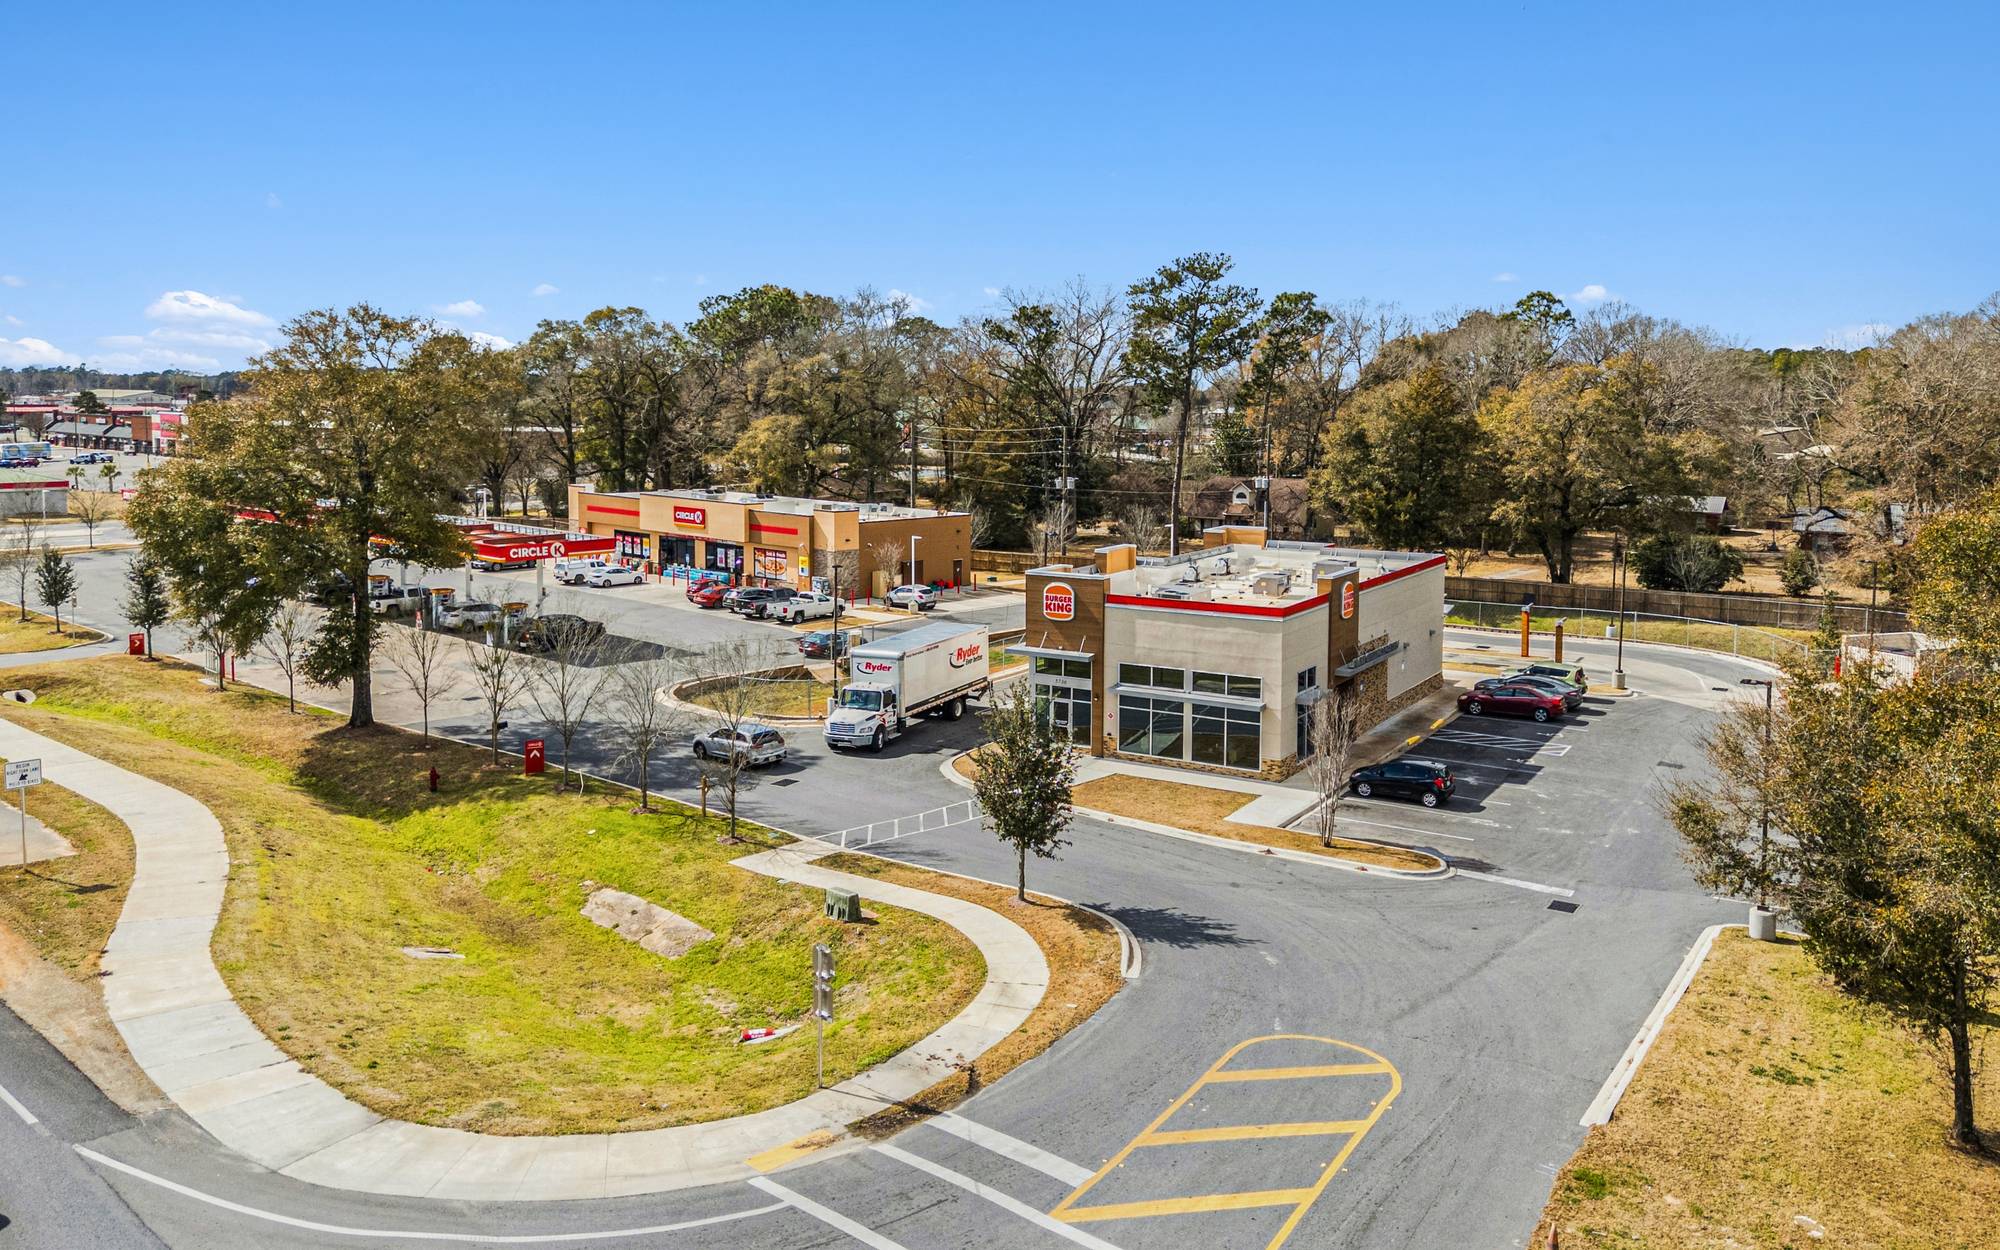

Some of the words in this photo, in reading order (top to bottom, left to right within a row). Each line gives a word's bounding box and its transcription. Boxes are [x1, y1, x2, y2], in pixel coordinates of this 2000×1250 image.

[676, 511, 694, 520] CIRCLE
[695, 511, 702, 523] K
[510, 546, 548, 558] CIRCLE
[551, 543, 565, 557] K
[1045, 594, 1072, 603] BURGER
[1045, 602, 1072, 613] KING
[957, 644, 980, 662] Ryder
[865, 662, 892, 672] Ryder
